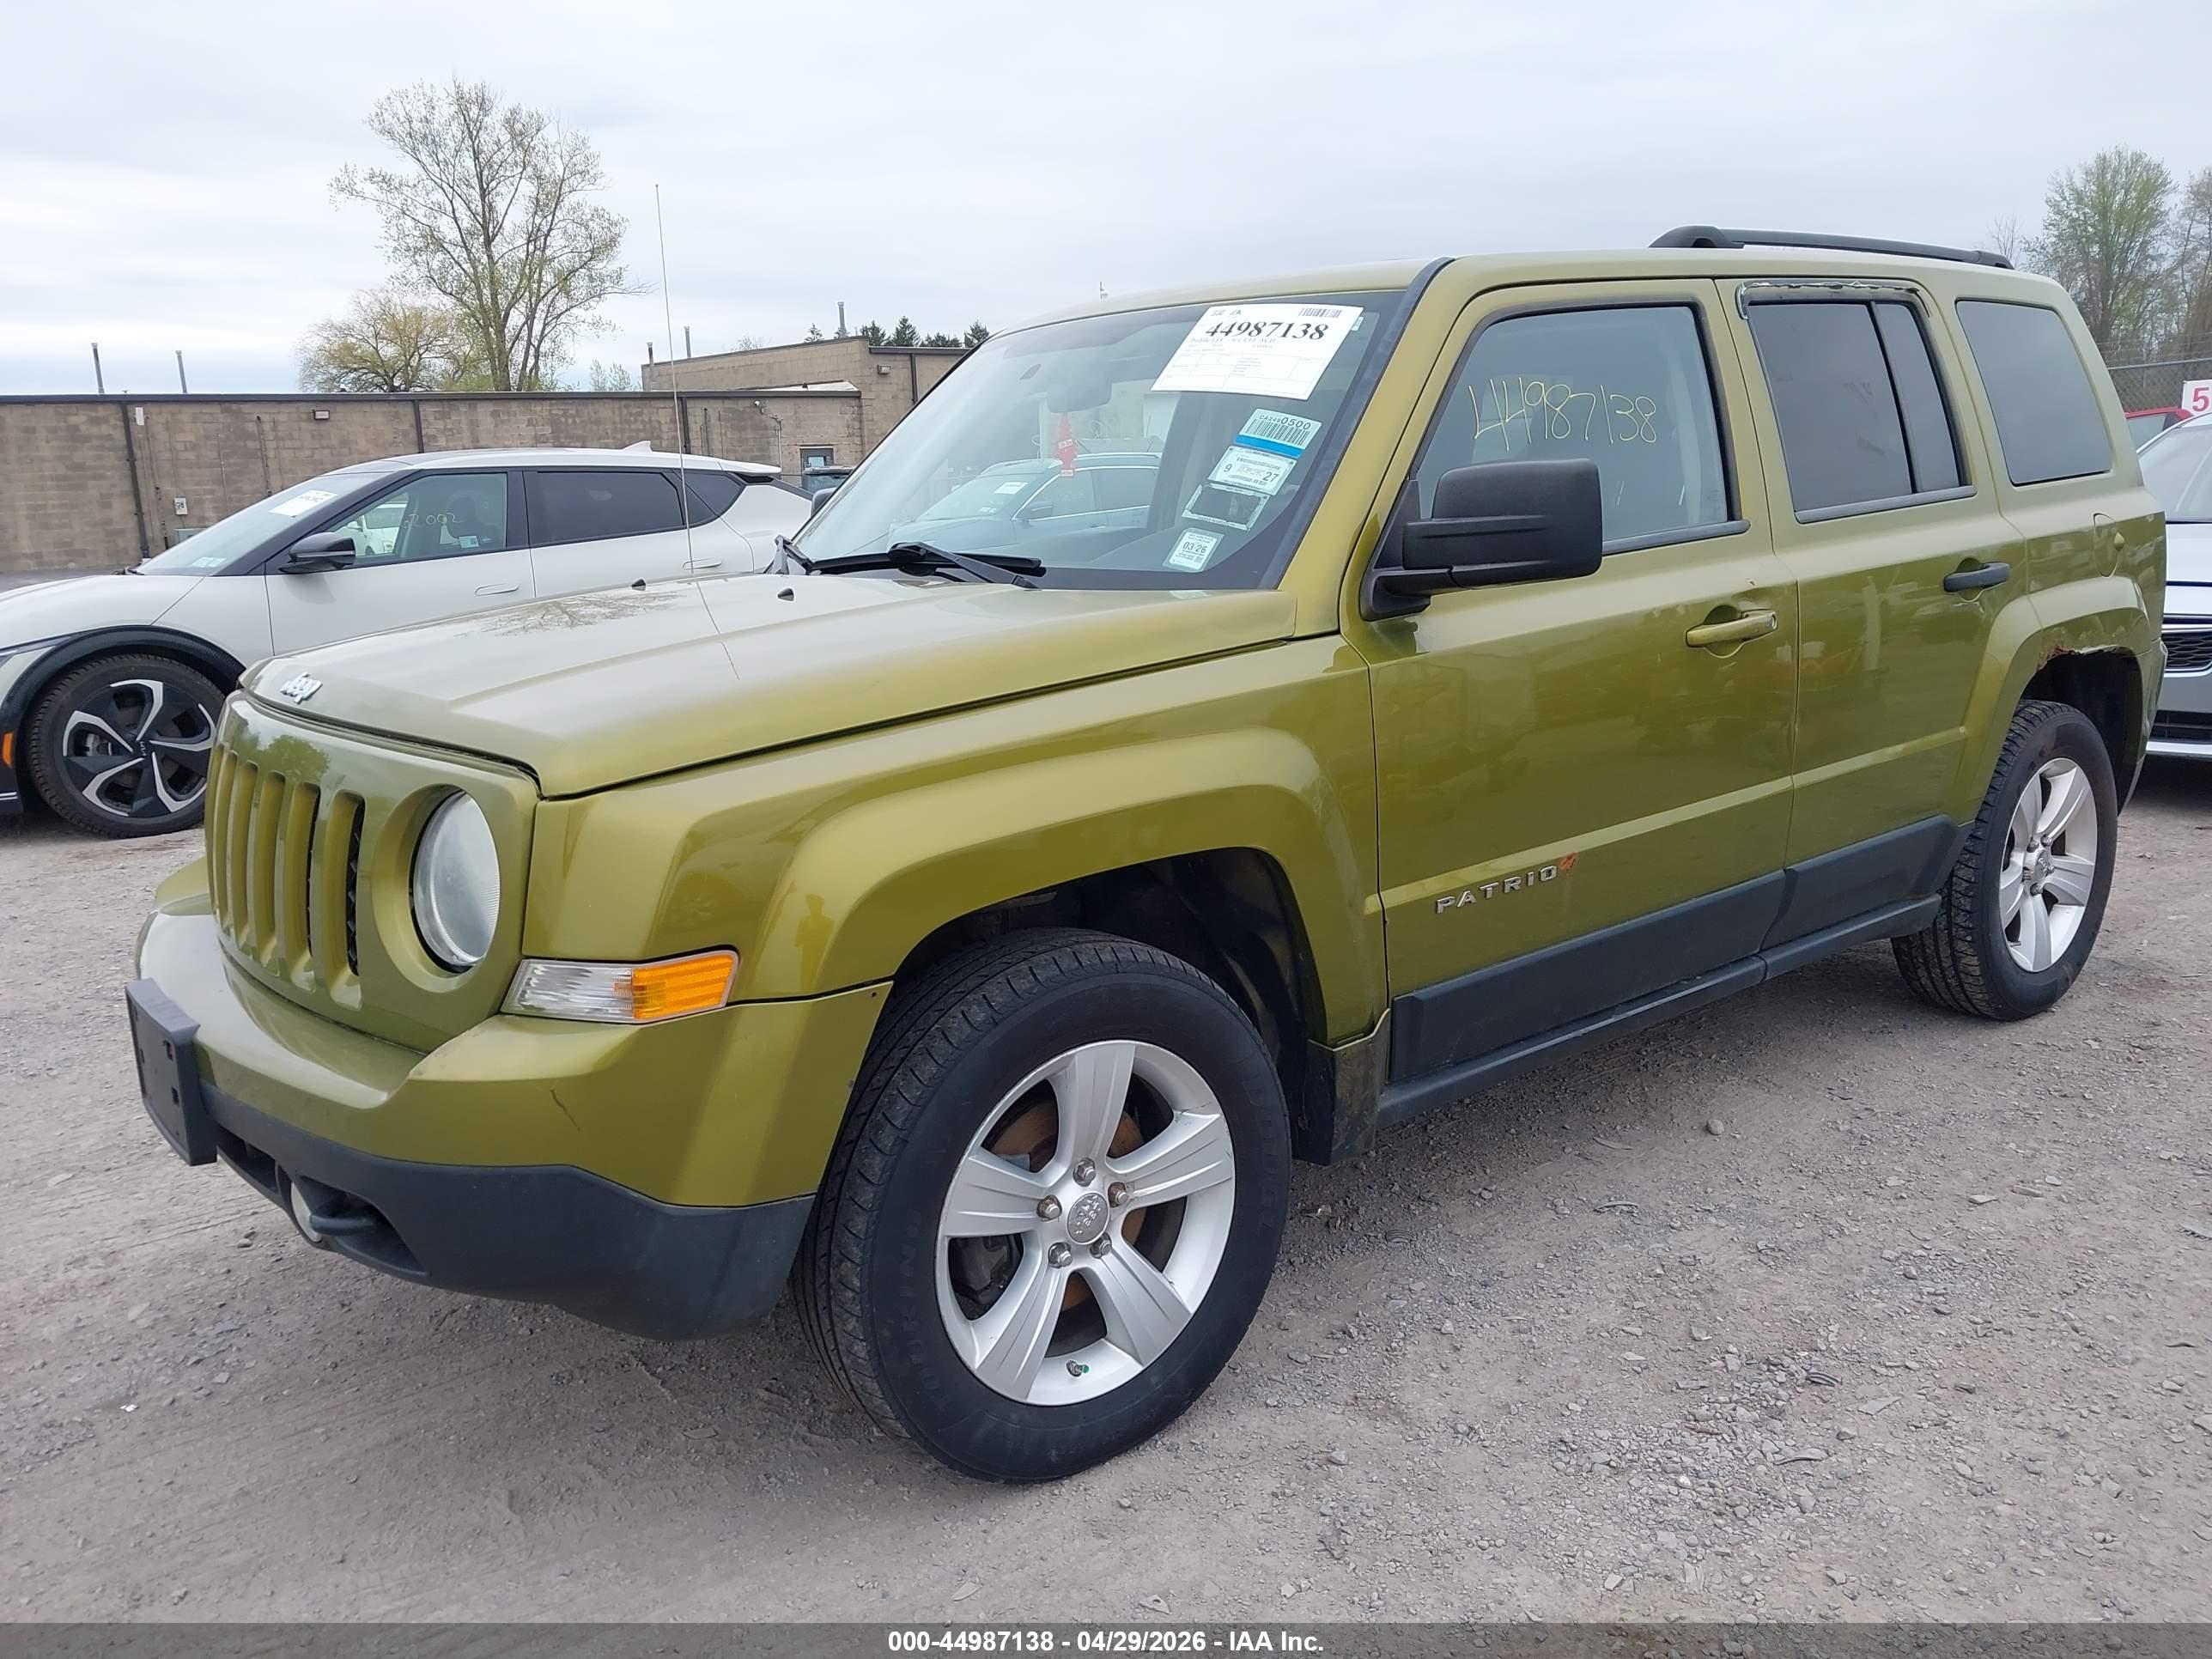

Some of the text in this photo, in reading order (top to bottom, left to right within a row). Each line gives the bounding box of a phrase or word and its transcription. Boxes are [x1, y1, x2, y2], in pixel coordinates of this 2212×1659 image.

[1205, 321, 1329, 341] 44987138
[2192, 387, 2209, 411] 5
[1468, 377, 1657, 452] 44987138
[1224, 464, 1232, 473] 9
[1262, 471, 1279, 483] 27
